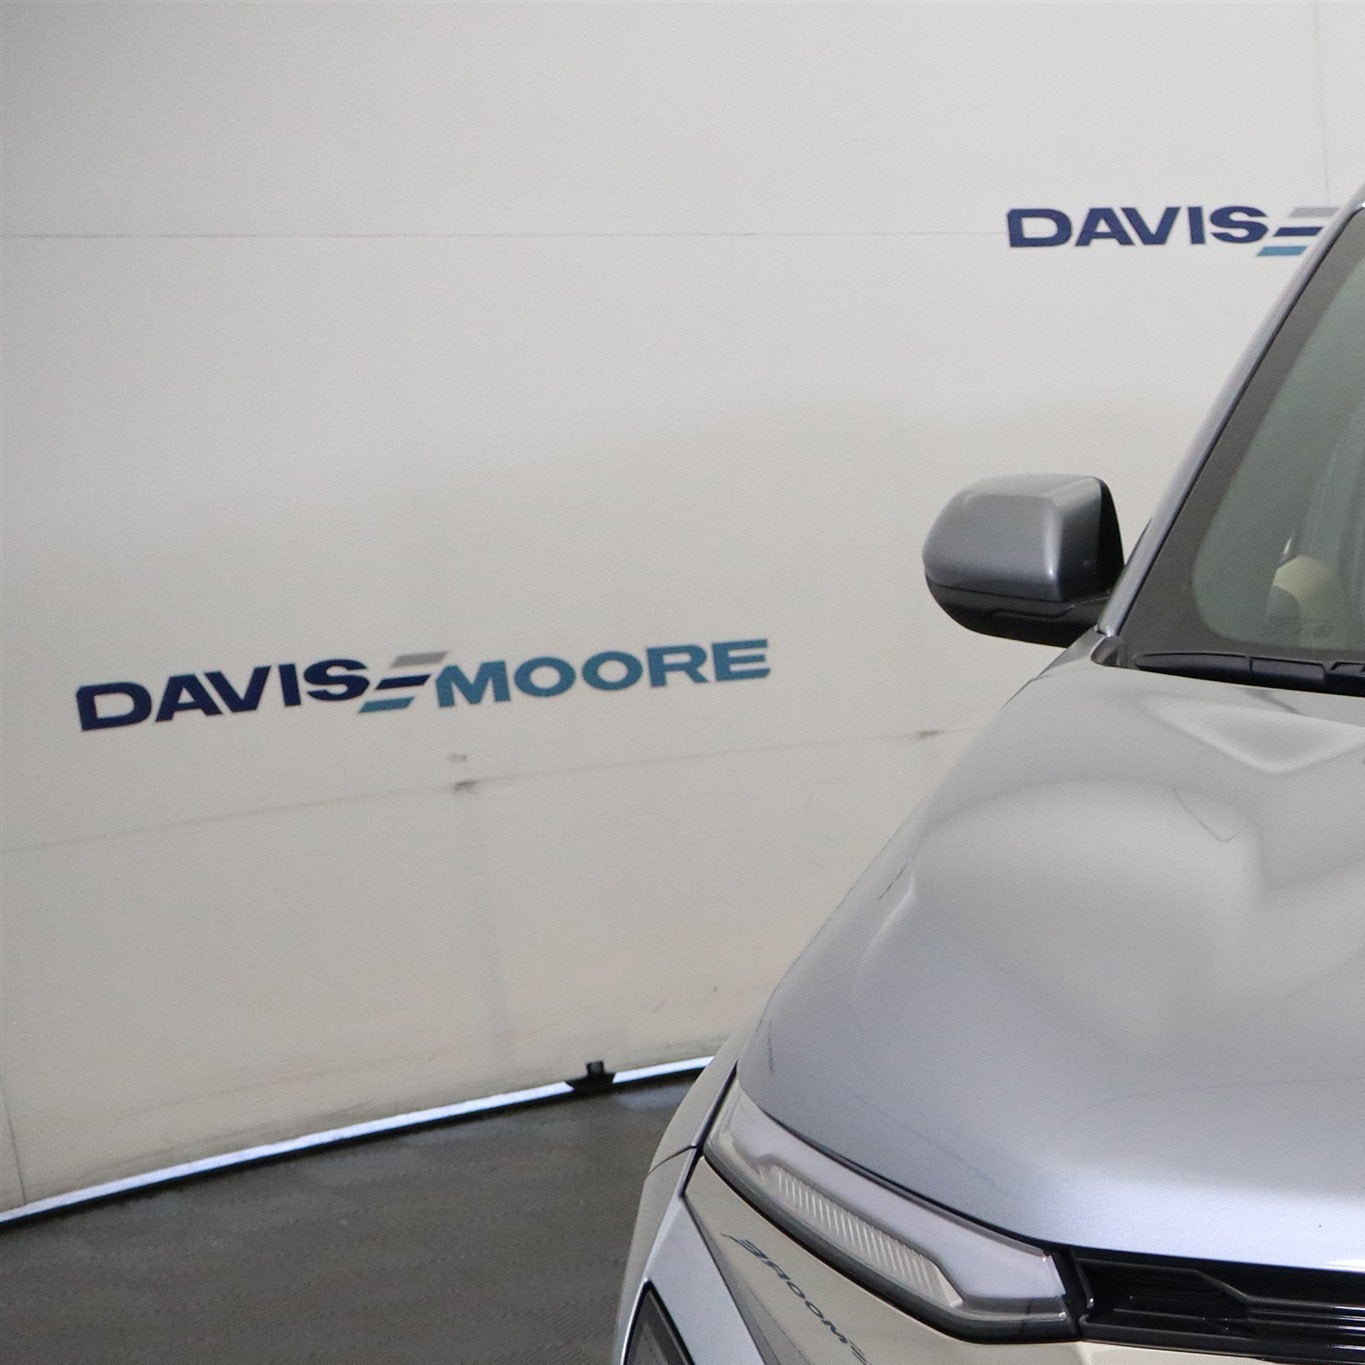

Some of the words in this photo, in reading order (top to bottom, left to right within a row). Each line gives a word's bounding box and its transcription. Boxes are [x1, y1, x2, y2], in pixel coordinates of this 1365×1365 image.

[1006, 206, 1270, 248] DAVIS
[75, 658, 371, 732] DAVIS
[435, 639, 770, 708] MOORE
